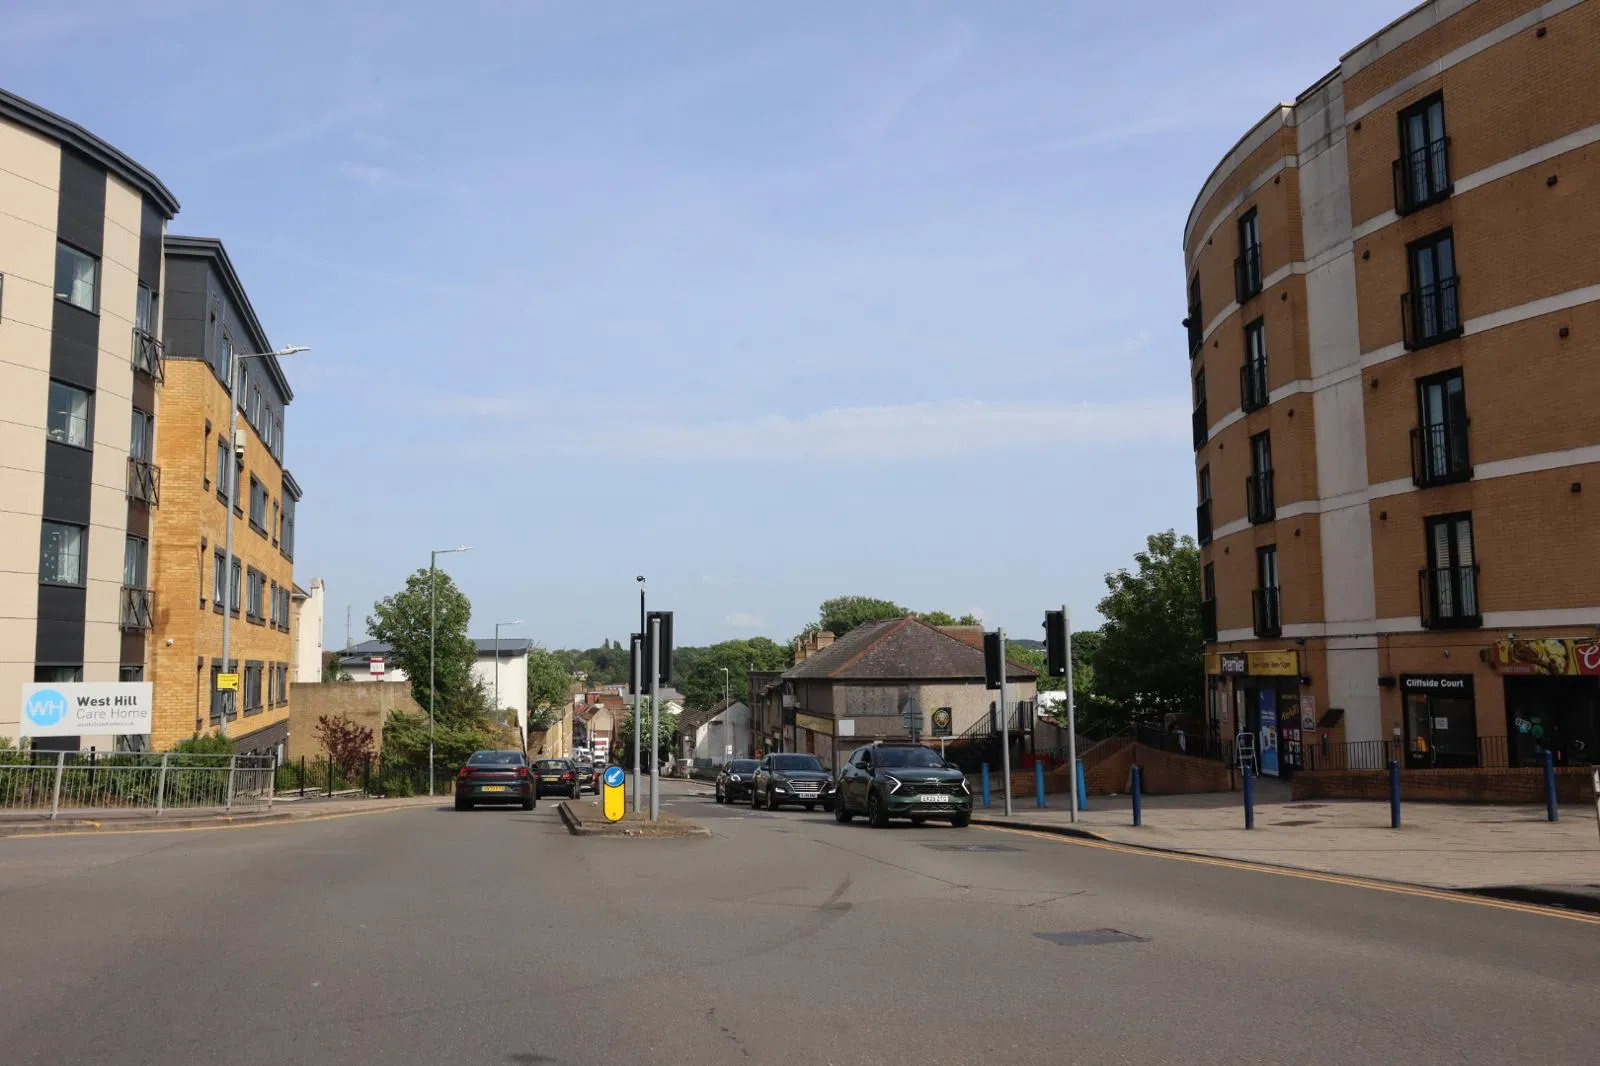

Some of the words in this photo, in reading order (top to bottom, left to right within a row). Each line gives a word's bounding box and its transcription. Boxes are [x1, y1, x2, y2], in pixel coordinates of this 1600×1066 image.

[1222, 656, 1245, 673] Premier
[1406, 679, 1439, 687] Cliffside
[1441, 679, 1464, 687] Court
[77, 696, 110, 707] West
[114, 696, 137, 706] Hill
[28, 700, 64, 719] WH
[77, 708, 106, 720] Care
[111, 707, 147, 718] Home
